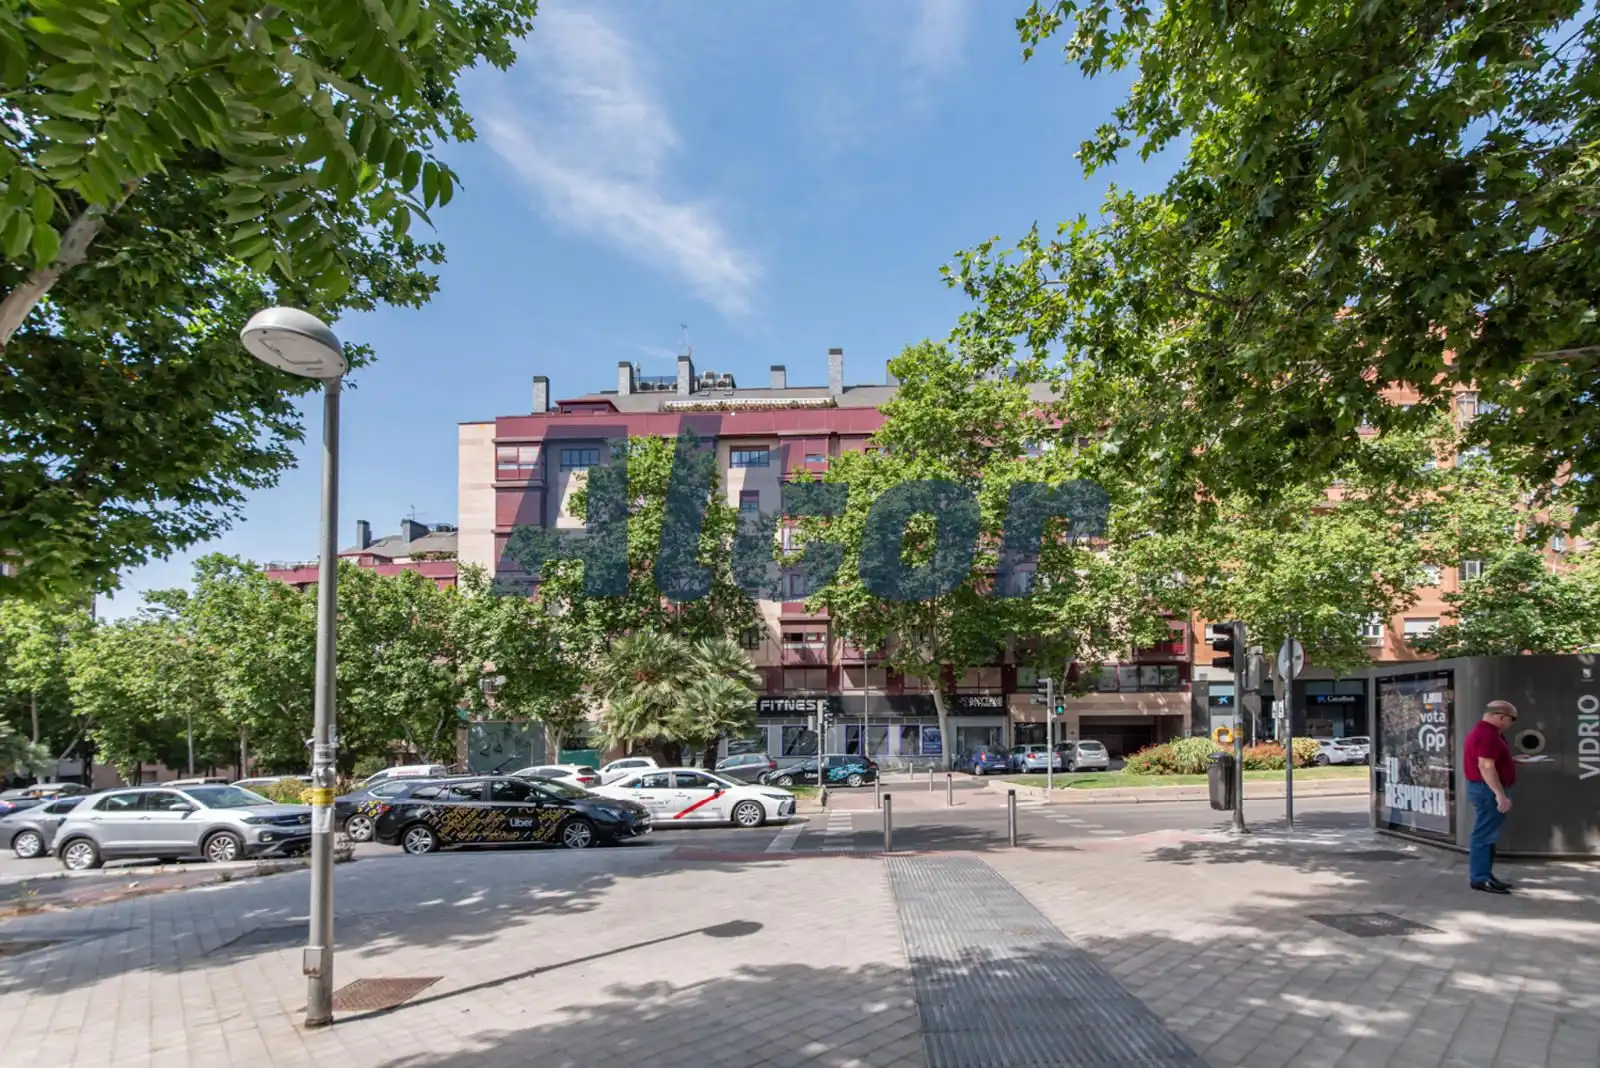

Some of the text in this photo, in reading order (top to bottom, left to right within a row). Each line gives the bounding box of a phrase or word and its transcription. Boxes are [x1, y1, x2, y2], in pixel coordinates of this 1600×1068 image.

[1419, 711, 1446, 723] vota
[1577, 694, 1600, 781] VIDRIO
[1385, 757, 1399, 783] TU
[1384, 782, 1447, 817] RESPUESTA
[509, 818, 534, 828] Uber
